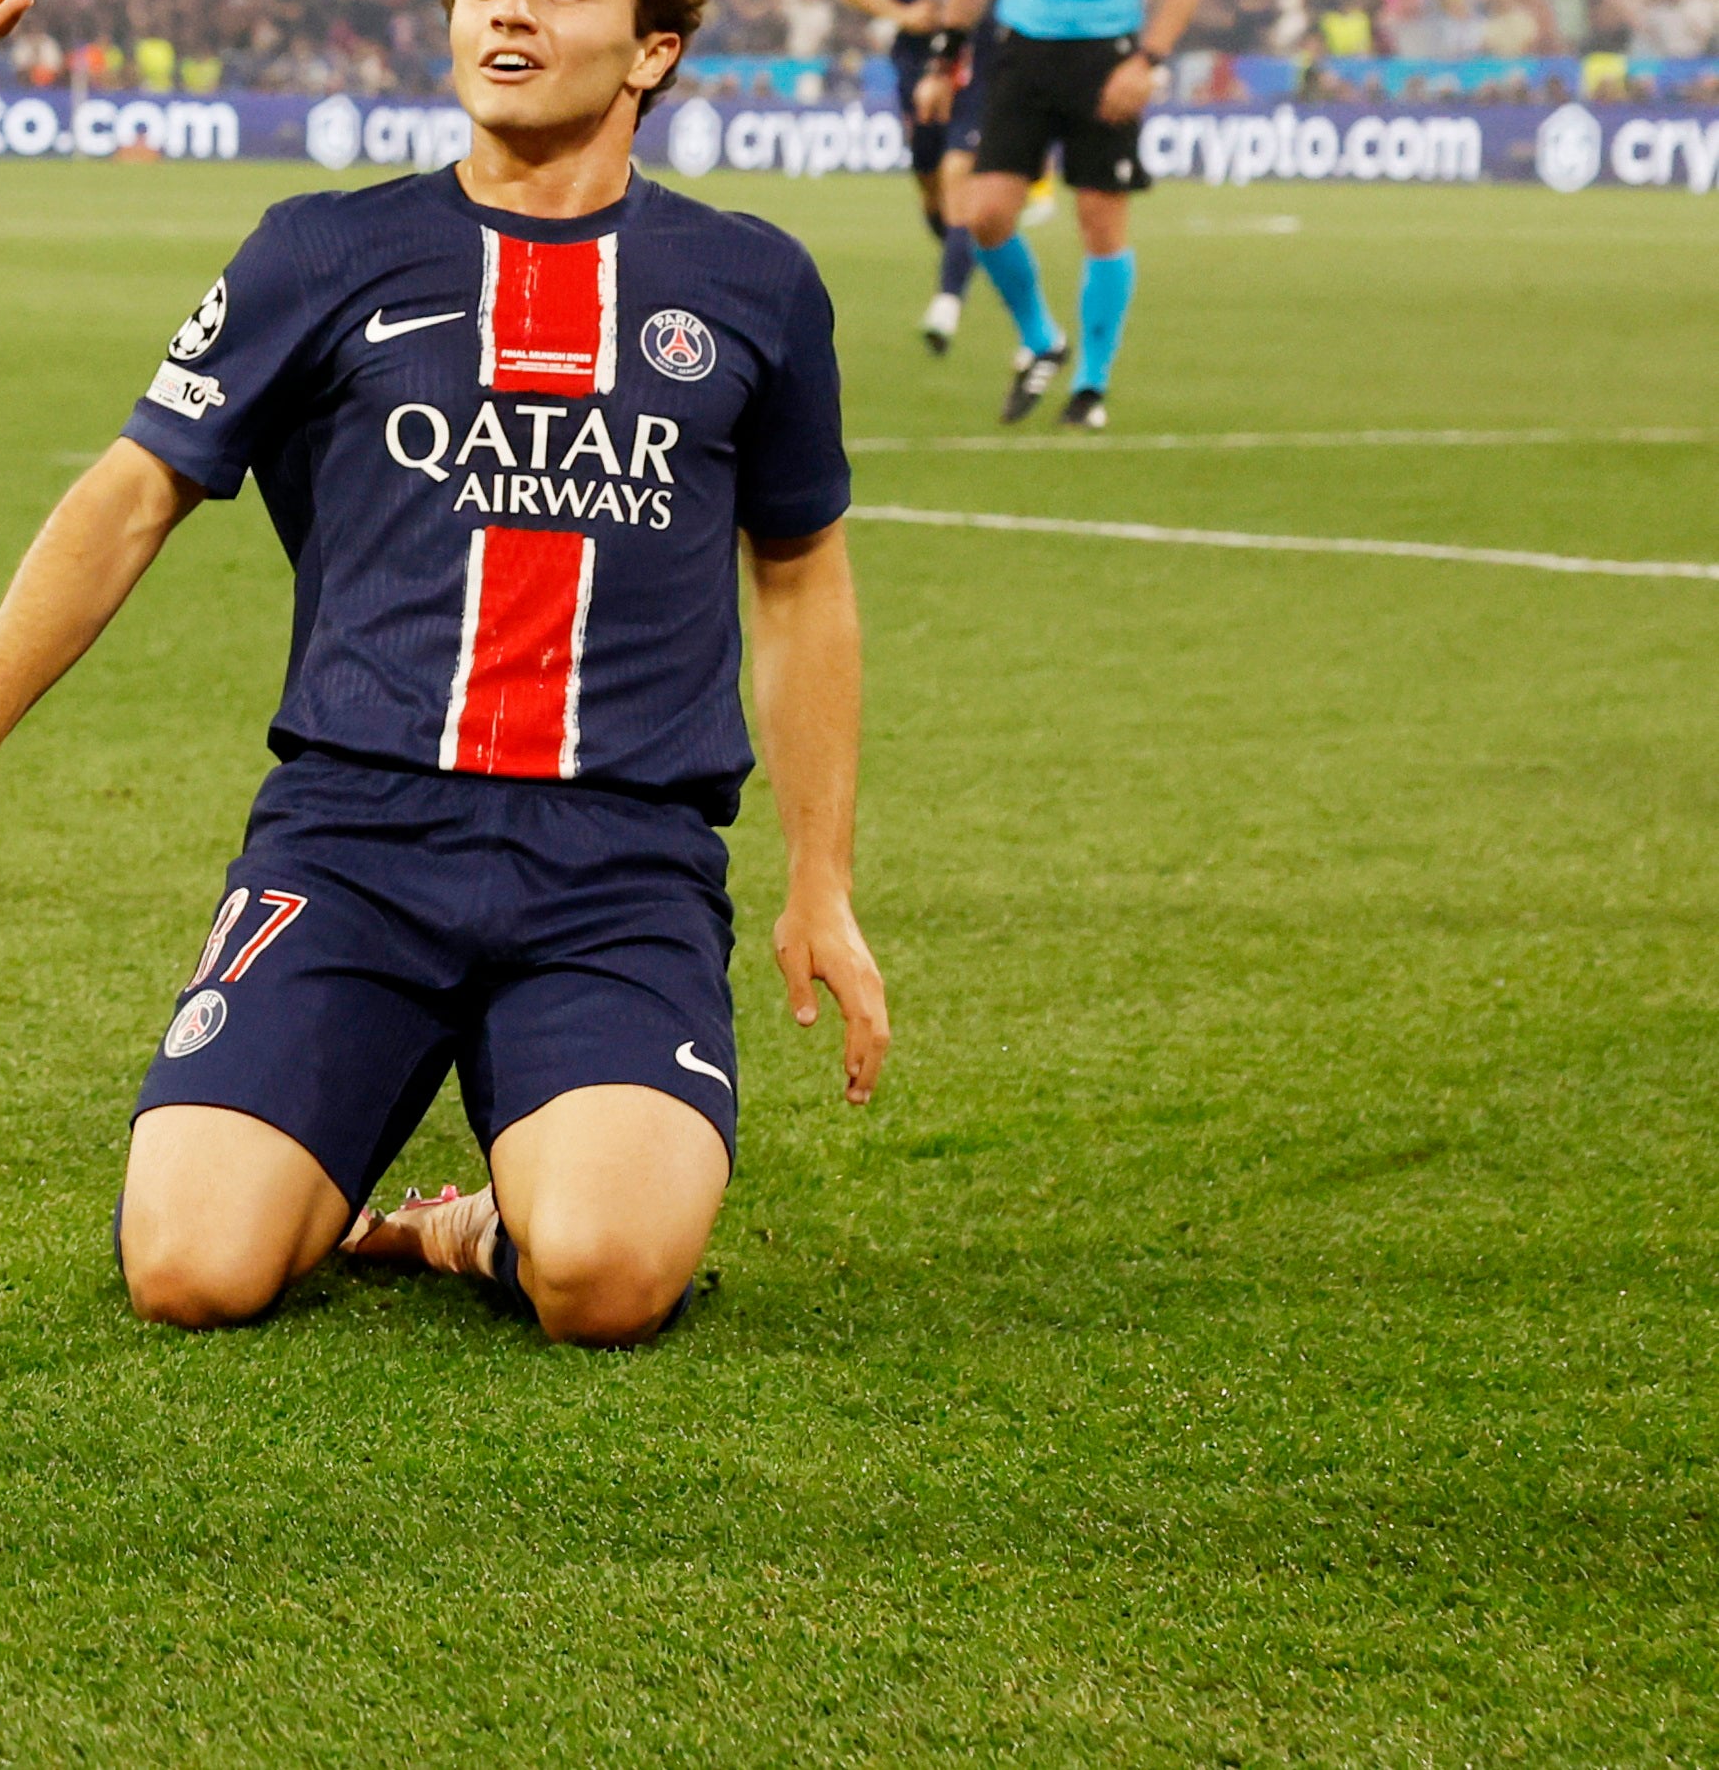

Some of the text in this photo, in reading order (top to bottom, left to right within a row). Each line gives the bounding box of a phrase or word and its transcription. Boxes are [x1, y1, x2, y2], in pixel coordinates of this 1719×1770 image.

[1139, 102, 1482, 187] crypto.com
[653, 314, 703, 336] PARIS
[385, 400, 679, 484] QATAR
[453, 472, 672, 530] AIRWAYS
